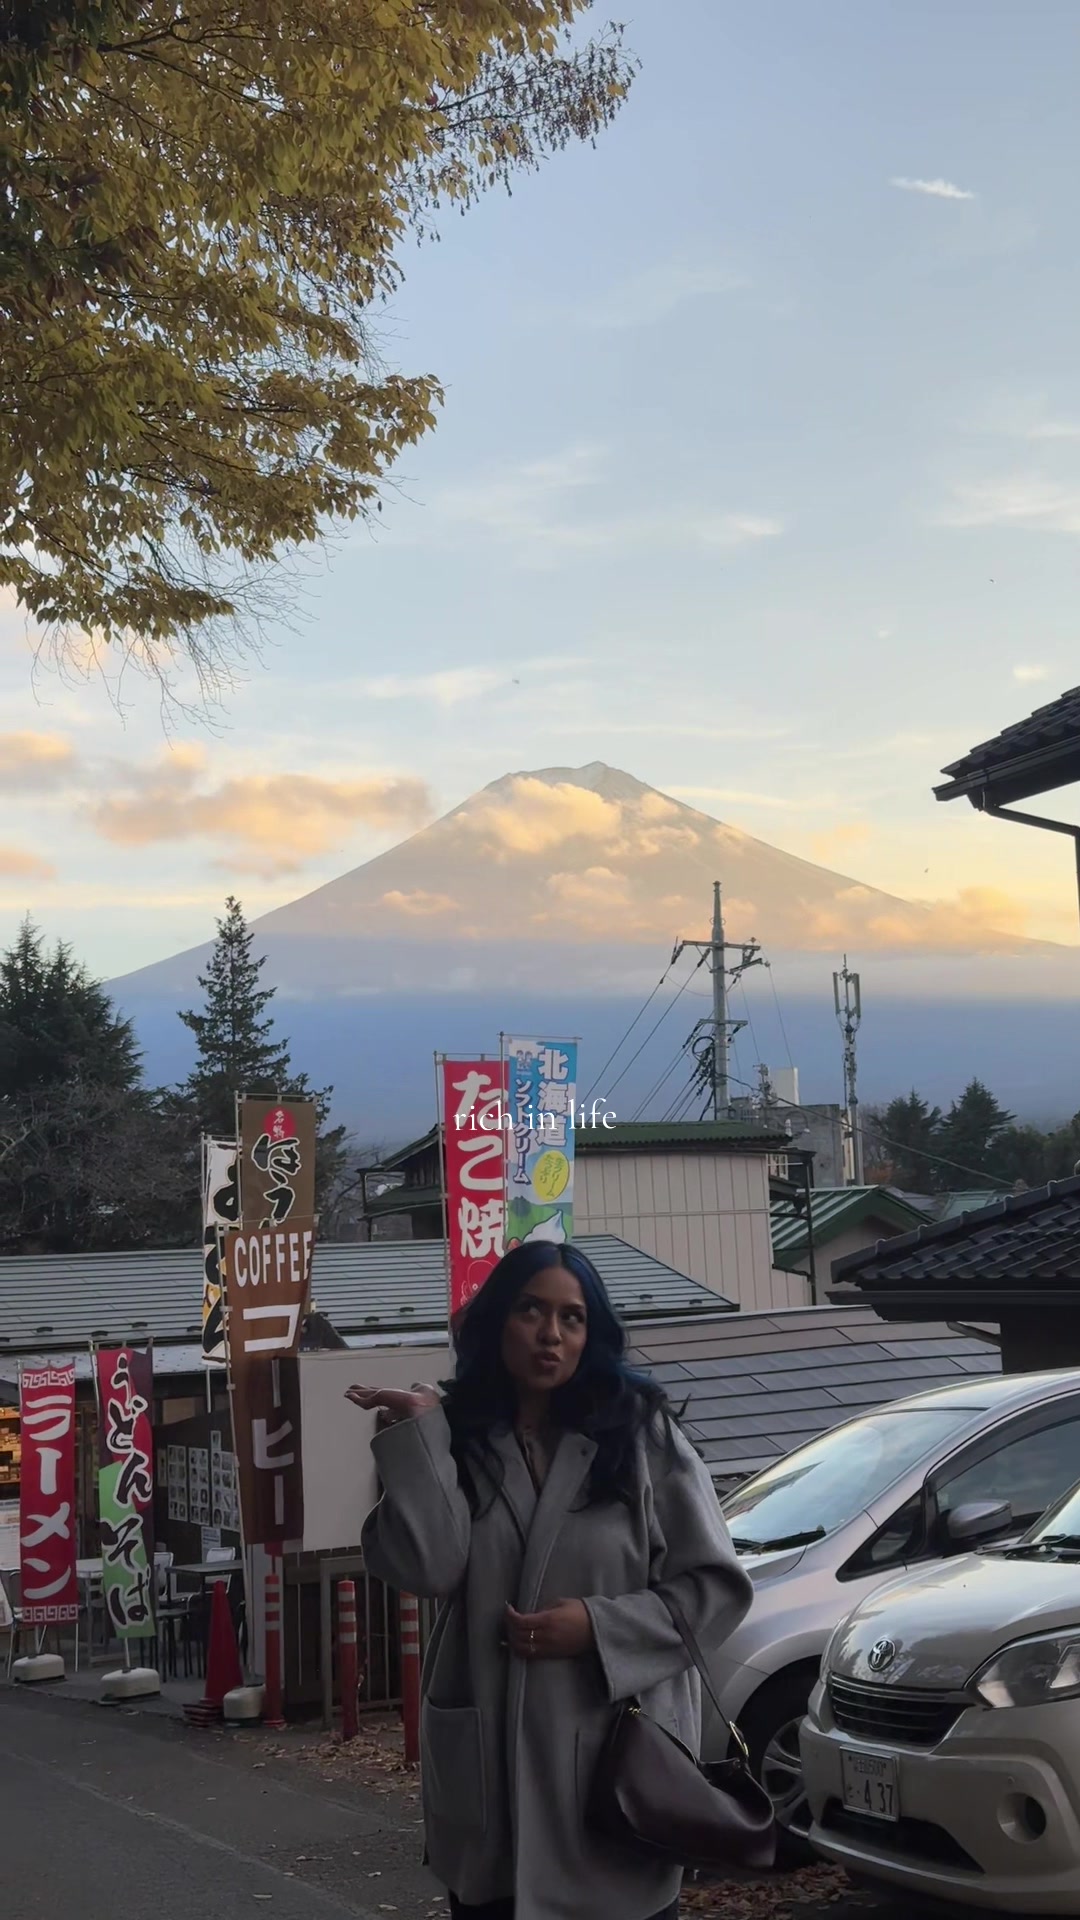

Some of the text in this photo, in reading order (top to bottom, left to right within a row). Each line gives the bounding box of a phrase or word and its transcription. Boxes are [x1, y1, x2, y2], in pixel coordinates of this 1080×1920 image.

[452, 1070, 508, 1259] たこ焼
[513, 1078, 531, 1184] ソフトクリーム
[536, 1049, 569, 1147] 北海道
[234, 1230, 313, 1288] COFFEE
[243, 1303, 301, 1525] コーヒー
[21, 1395, 73, 1600] ラーメン
